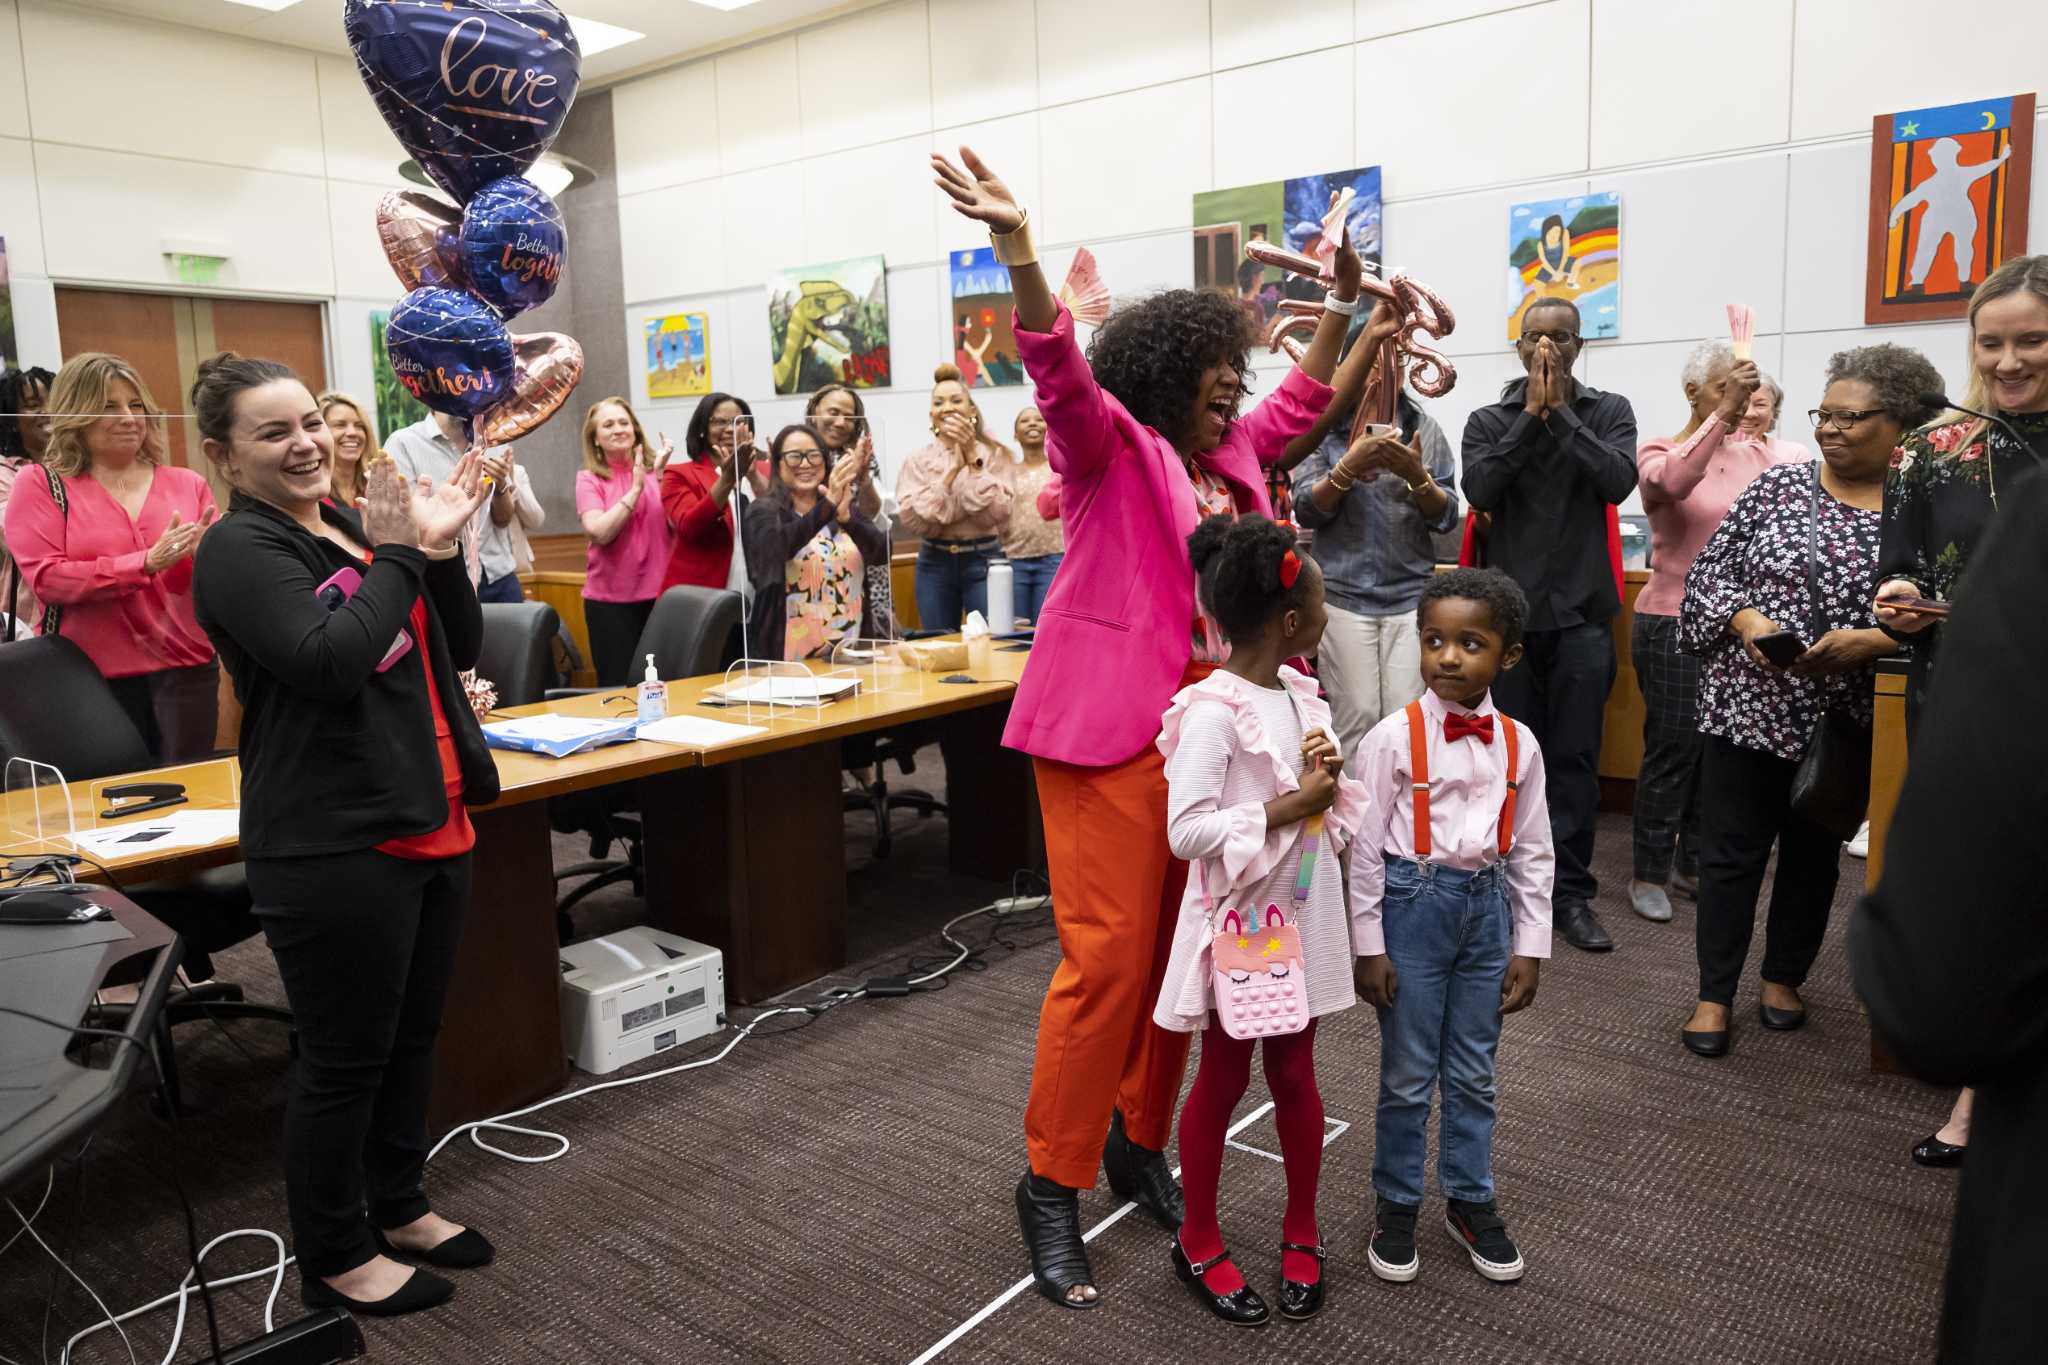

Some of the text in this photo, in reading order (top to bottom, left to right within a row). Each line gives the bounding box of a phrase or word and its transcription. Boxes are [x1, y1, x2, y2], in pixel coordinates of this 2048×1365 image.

[426, 16, 558, 108] love
[516, 232, 550, 256] Better
[391, 352, 425, 373] Better
